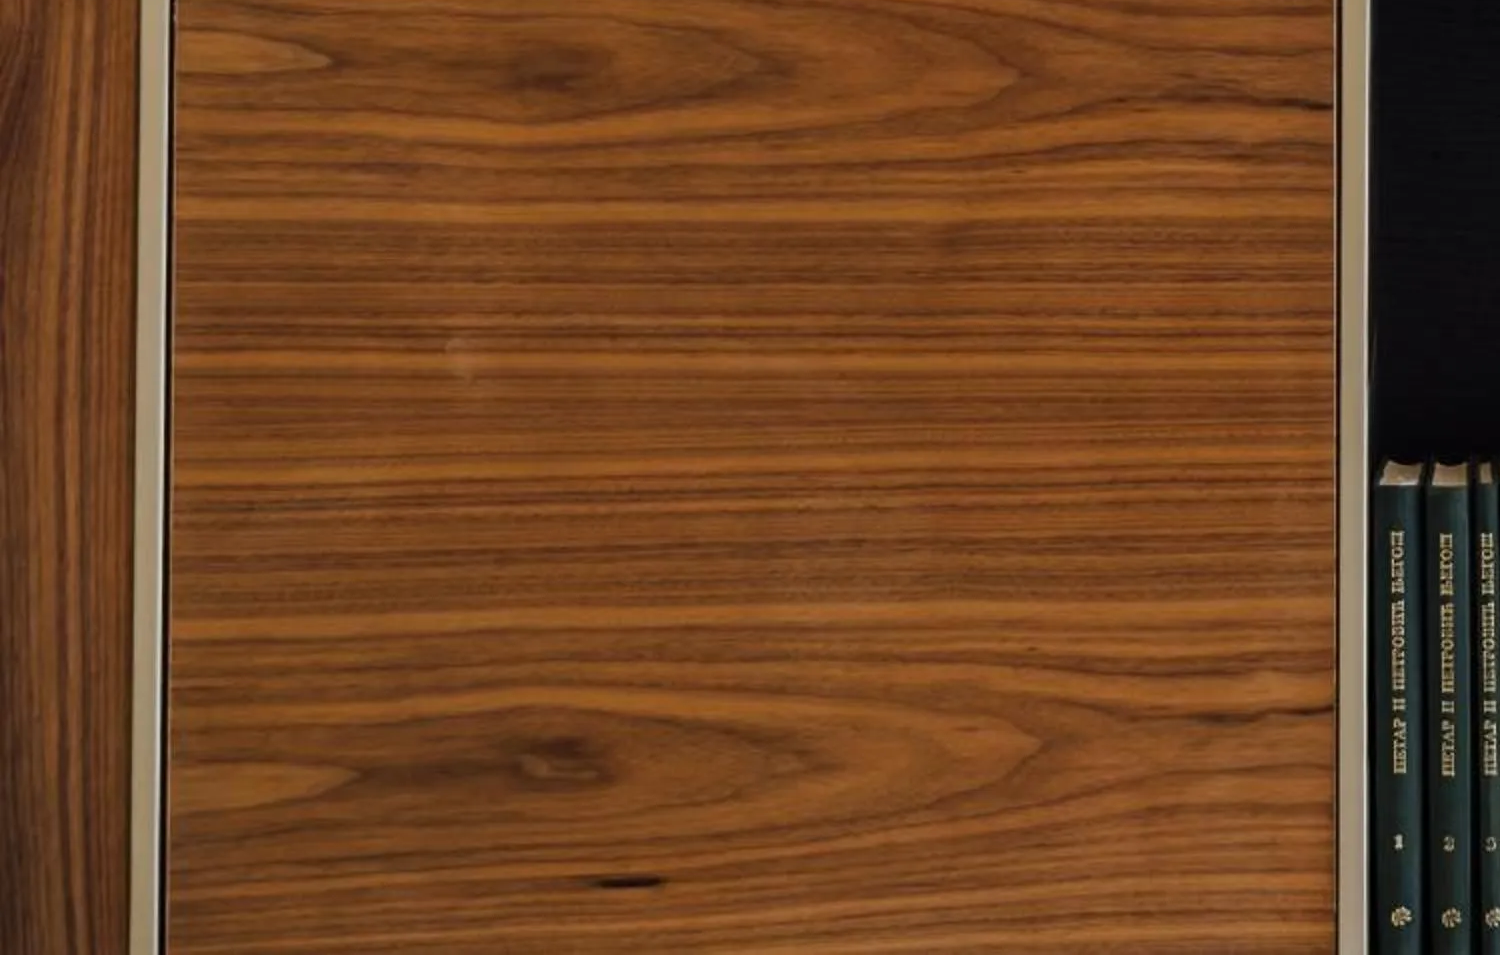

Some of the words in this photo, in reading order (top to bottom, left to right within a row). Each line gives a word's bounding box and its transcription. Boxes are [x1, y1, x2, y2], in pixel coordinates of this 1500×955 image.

[1393, 719, 1408, 775] ПЕТАР
[1442, 719, 1456, 777] ПЕТАР
[1484, 720, 1498, 777] ПЕТАР
[1394, 834, 1404, 850] 1
